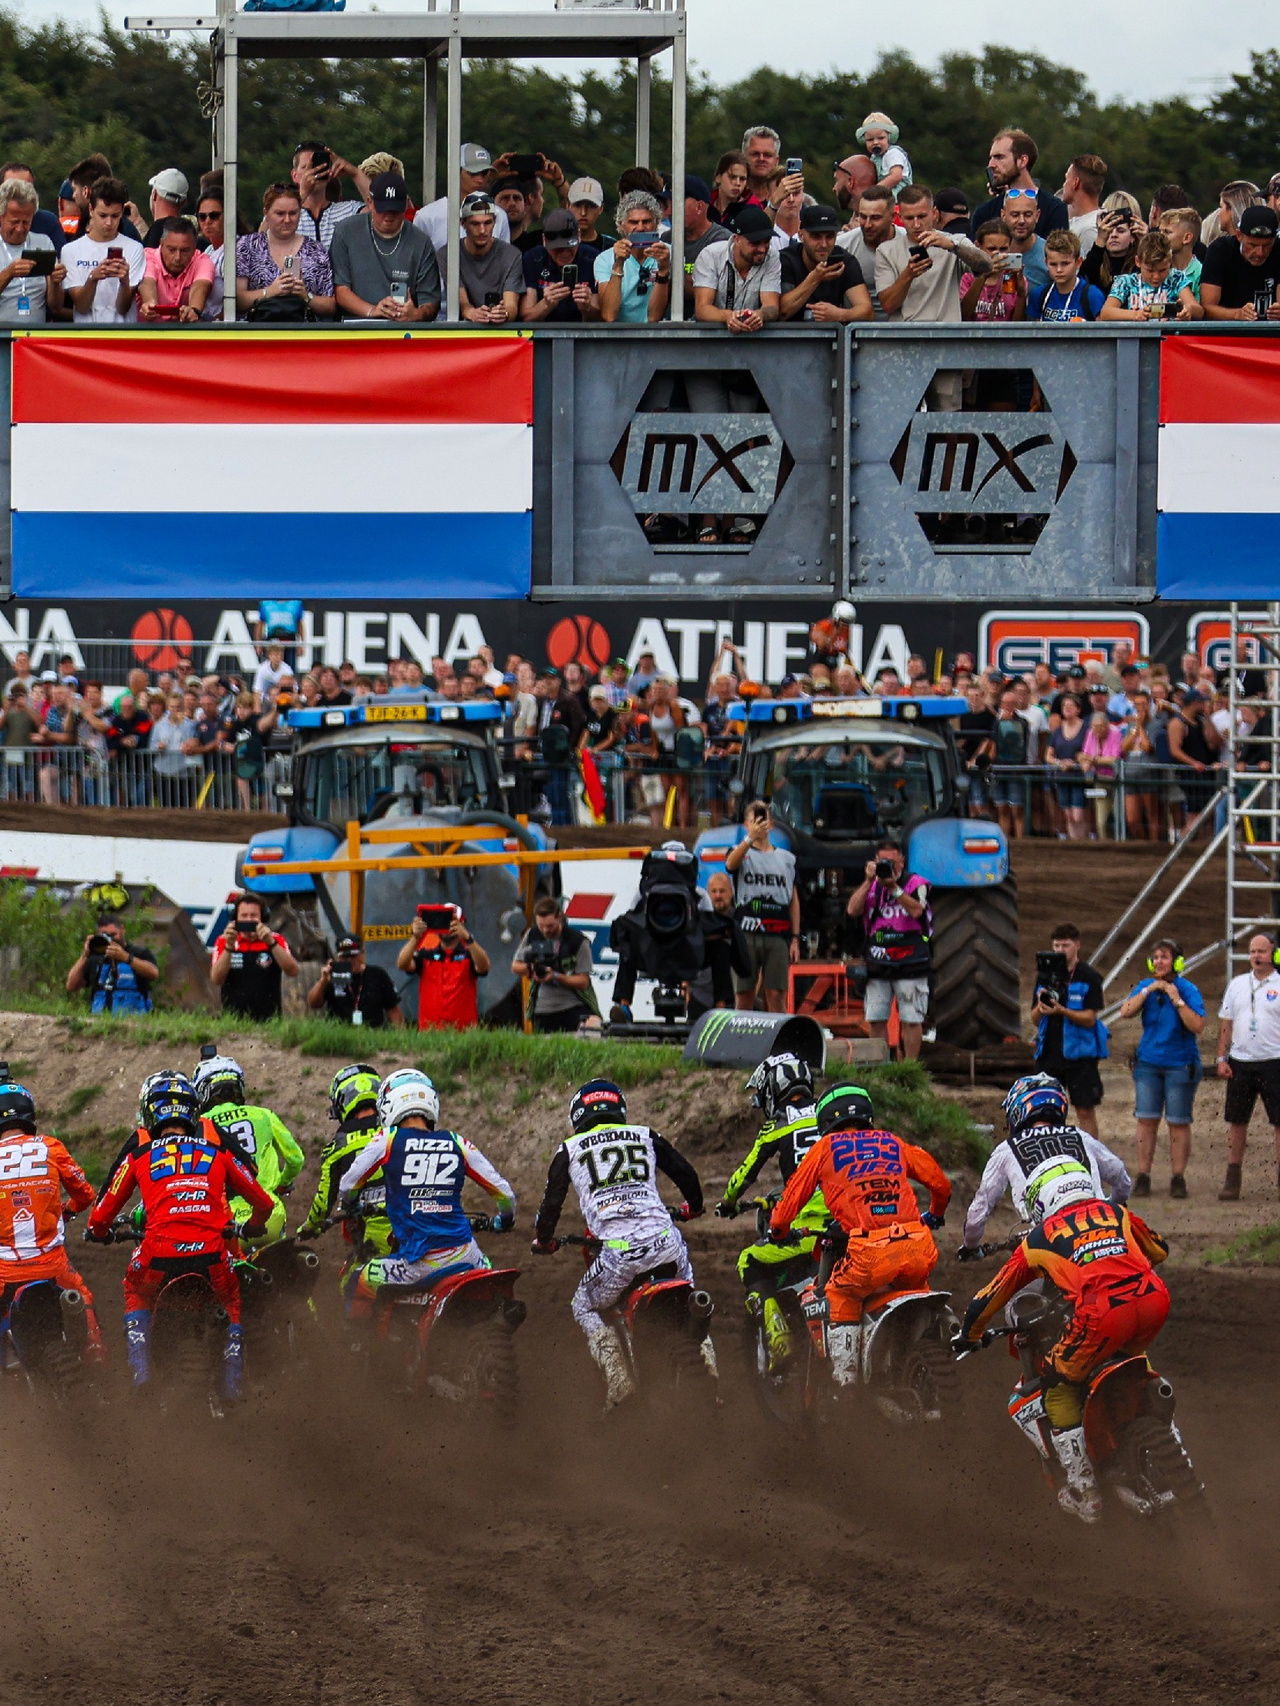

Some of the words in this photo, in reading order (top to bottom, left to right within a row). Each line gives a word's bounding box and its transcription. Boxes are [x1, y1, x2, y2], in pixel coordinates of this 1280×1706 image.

[744, 871, 787, 888] CREW
[584, 1092, 619, 1103] WECKMAN
[152, 1134, 208, 1149] GIFTING
[404, 1138, 453, 1151] RIZZI
[578, 1131, 641, 1151] WECKMAN
[830, 1131, 892, 1143] PANCAR
[149, 1144, 217, 1182] 517
[831, 1138, 901, 1173] 253
[401, 1153, 460, 1186] 912
[578, 1142, 650, 1193] 125
[847, 1161, 904, 1178] UFO
[18, 1179, 51, 1188] RACING
[855, 1178, 901, 1192] TEM
[173, 1190, 206, 1201] VHR
[864, 1191, 900, 1205] KTM
[169, 1204, 211, 1214] GASGAS
[1042, 1198, 1120, 1244] 470
[1073, 1228, 1117, 1250] KTM
[804, 1301, 826, 1317] TEM
